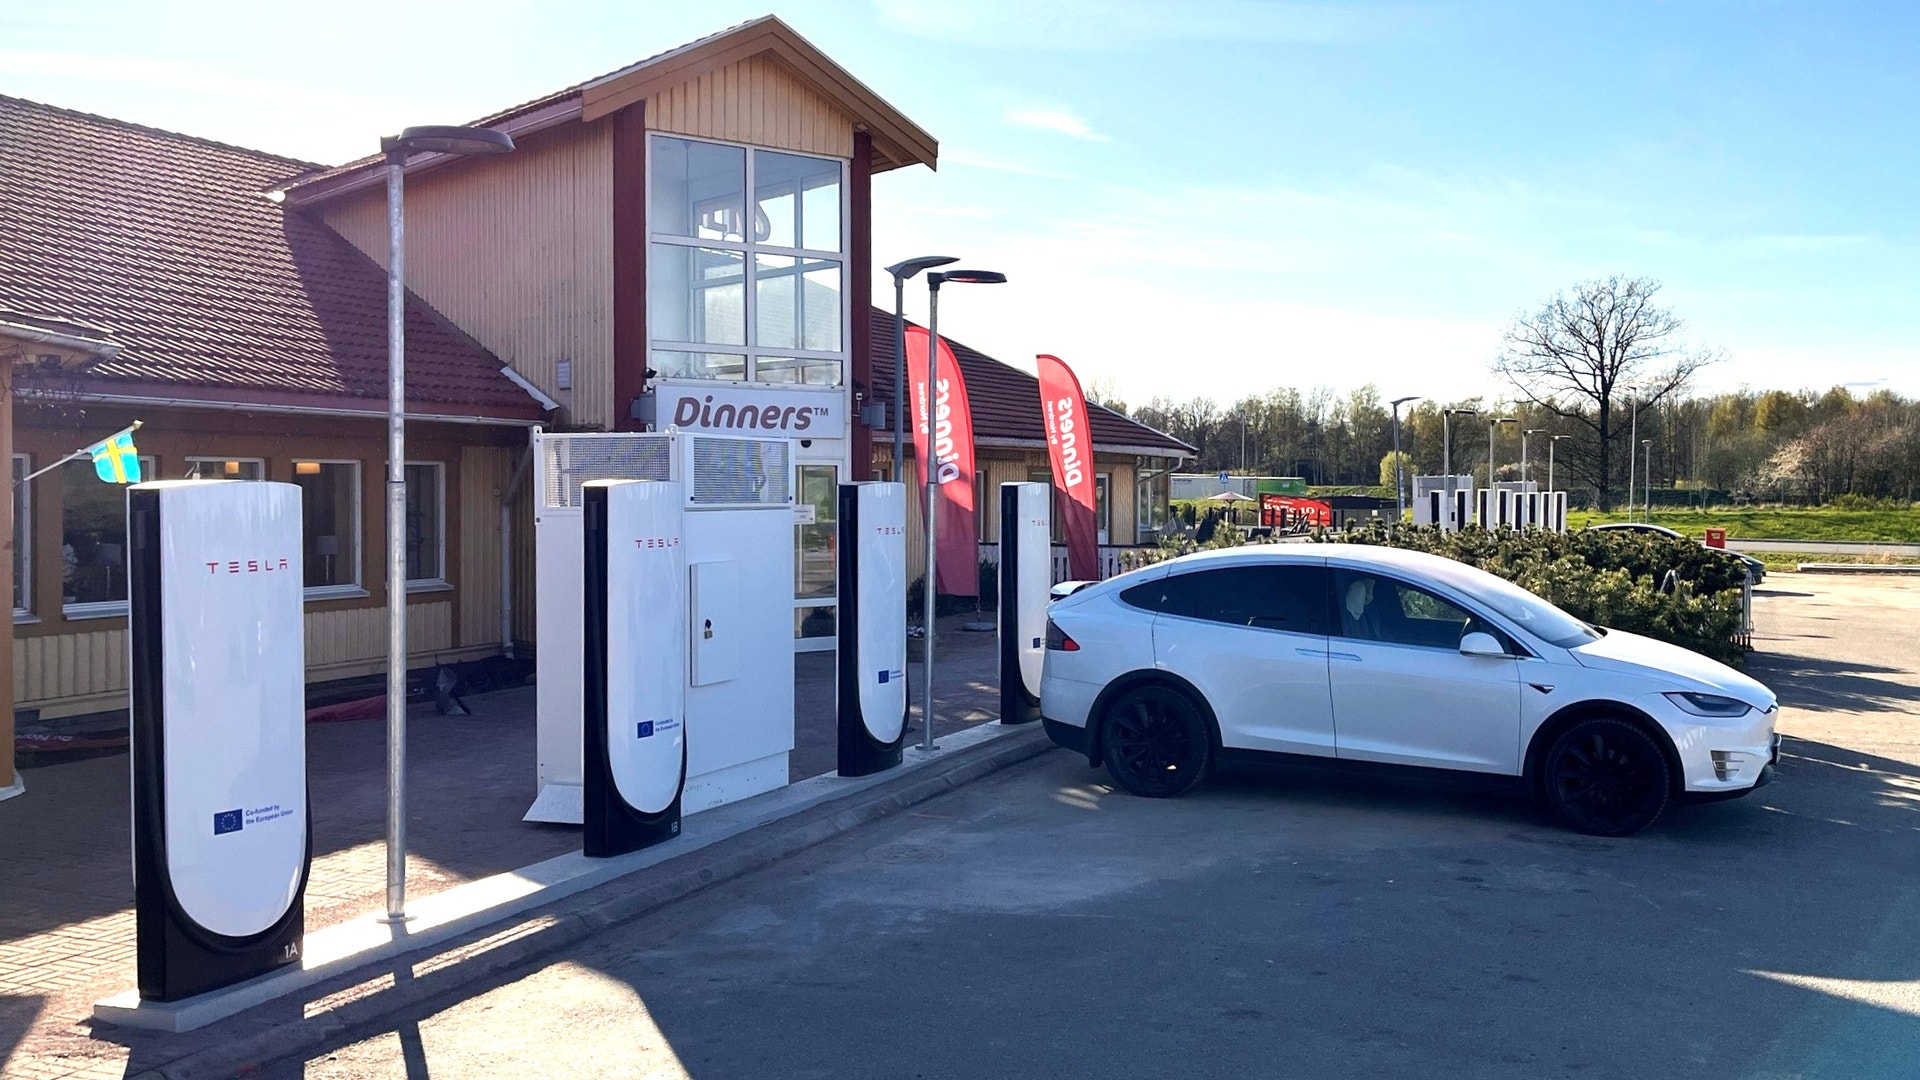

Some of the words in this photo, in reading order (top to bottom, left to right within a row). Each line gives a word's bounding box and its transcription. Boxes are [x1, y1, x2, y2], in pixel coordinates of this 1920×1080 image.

[634, 537, 679, 549] TESLA
[206, 558, 288, 574] TESLA
[284, 942, 298, 959] 1A
